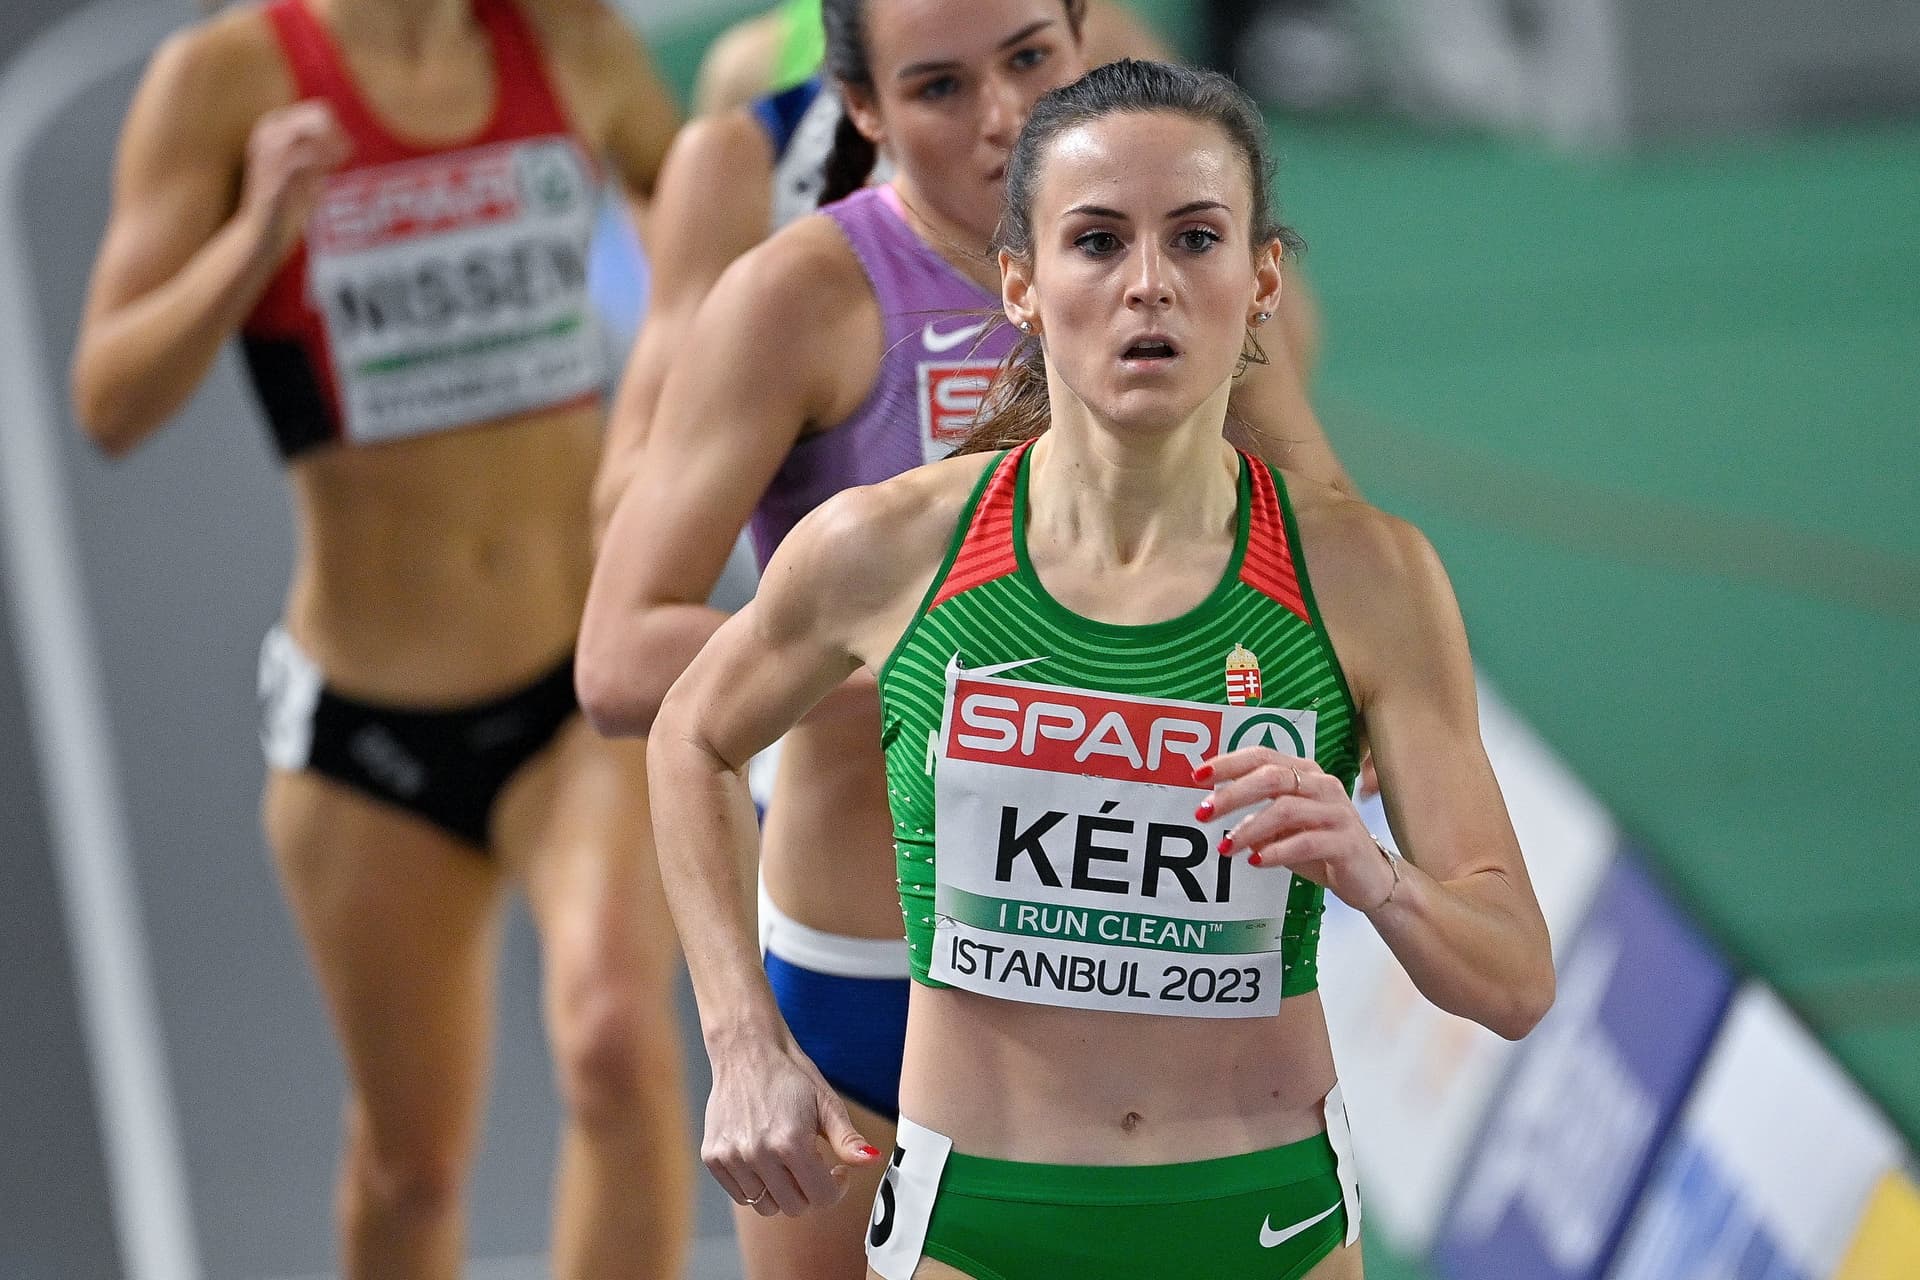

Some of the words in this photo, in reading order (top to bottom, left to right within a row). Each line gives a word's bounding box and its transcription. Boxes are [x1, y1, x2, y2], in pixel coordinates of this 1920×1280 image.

[335, 237, 588, 333] NISSEN
[957, 694, 1212, 771] SPAR
[995, 801, 1232, 903] KÉRI
[1000, 903, 1008, 930] I
[1018, 905, 1089, 938] RUN
[951, 936, 1151, 999] ISTANBUL
[1160, 966, 1261, 1004] 2023
